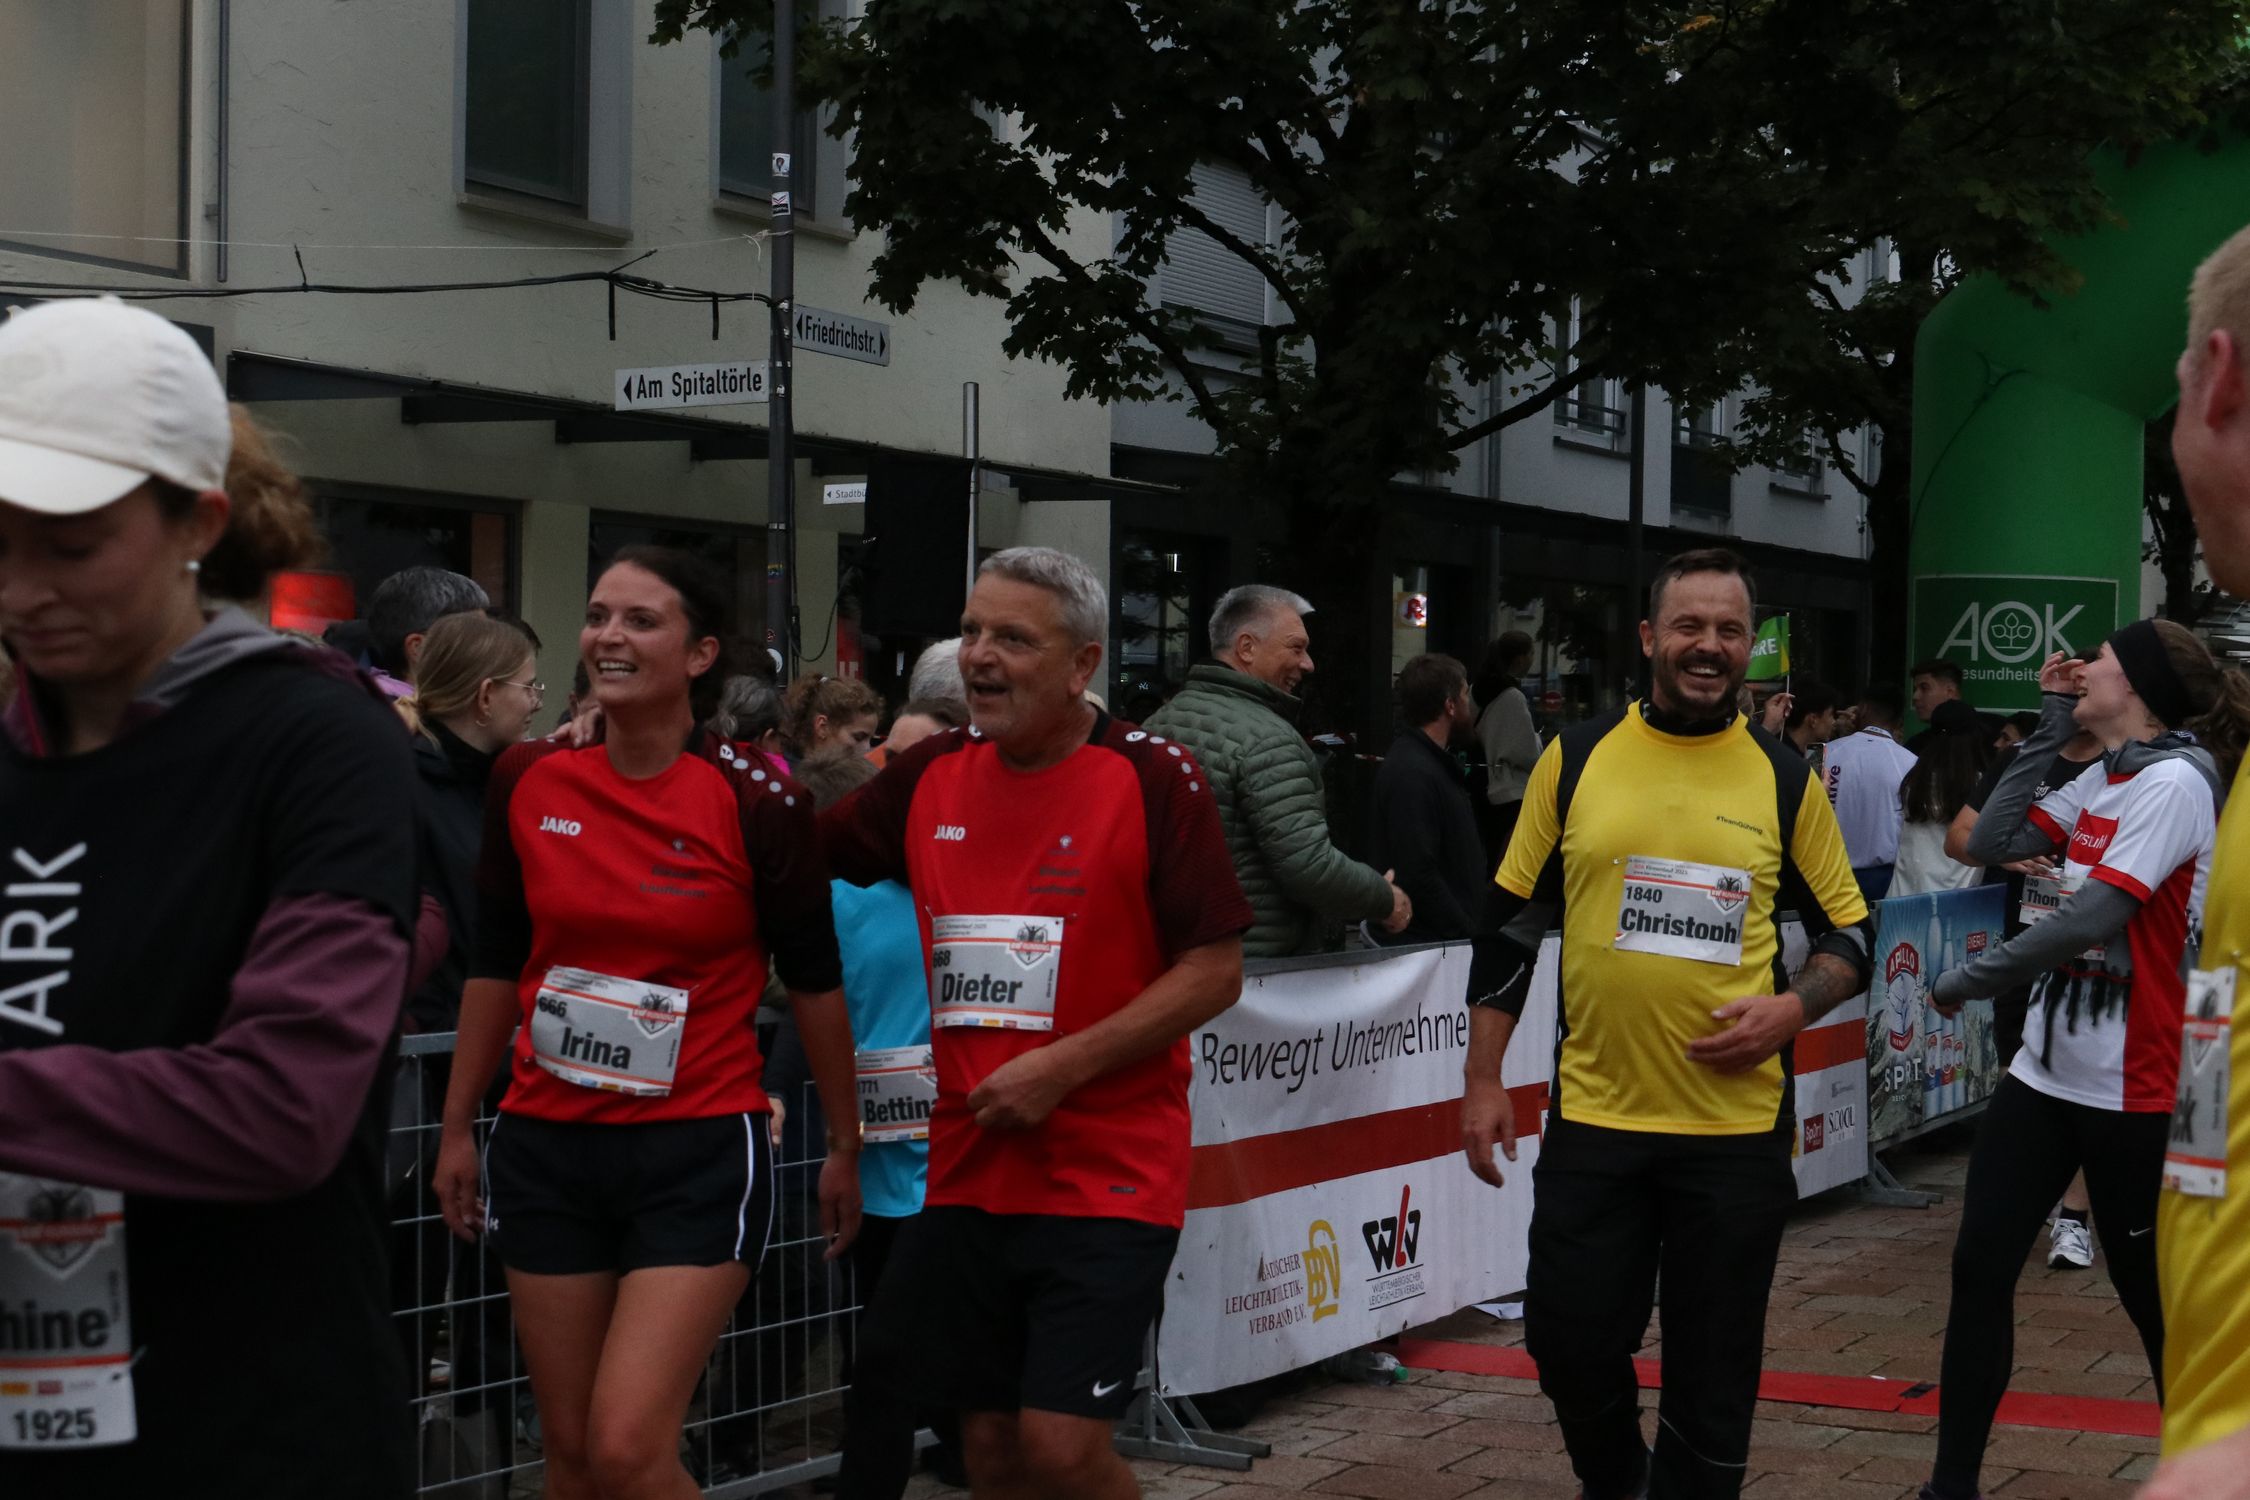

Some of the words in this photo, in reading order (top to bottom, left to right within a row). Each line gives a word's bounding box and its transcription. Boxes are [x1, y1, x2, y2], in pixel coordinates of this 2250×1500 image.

[805, 315, 876, 355] Friedrichstr.
[637, 374, 663, 399] Am
[671, 367, 762, 403] Spitaltörle
[1936, 600, 2085, 664] AOK
[539, 815, 582, 837] JAKO
[934, 824, 967, 841] JAKO
[1626, 886, 1663, 903] 1840
[1889, 947, 1915, 977] APLLO
[942, 972, 1022, 1004] Dieter
[538, 996, 568, 1018] 666
[560, 1026, 631, 1070] Irina
[1201, 1027, 1324, 1094] Bewegt
[1332, 1002, 1467, 1072] Unternehme
[1884, 1057, 1922, 1093] SPRT
[1249, 1307, 1293, 1335] VERBAND
[13, 1407, 96, 1441] 1925
